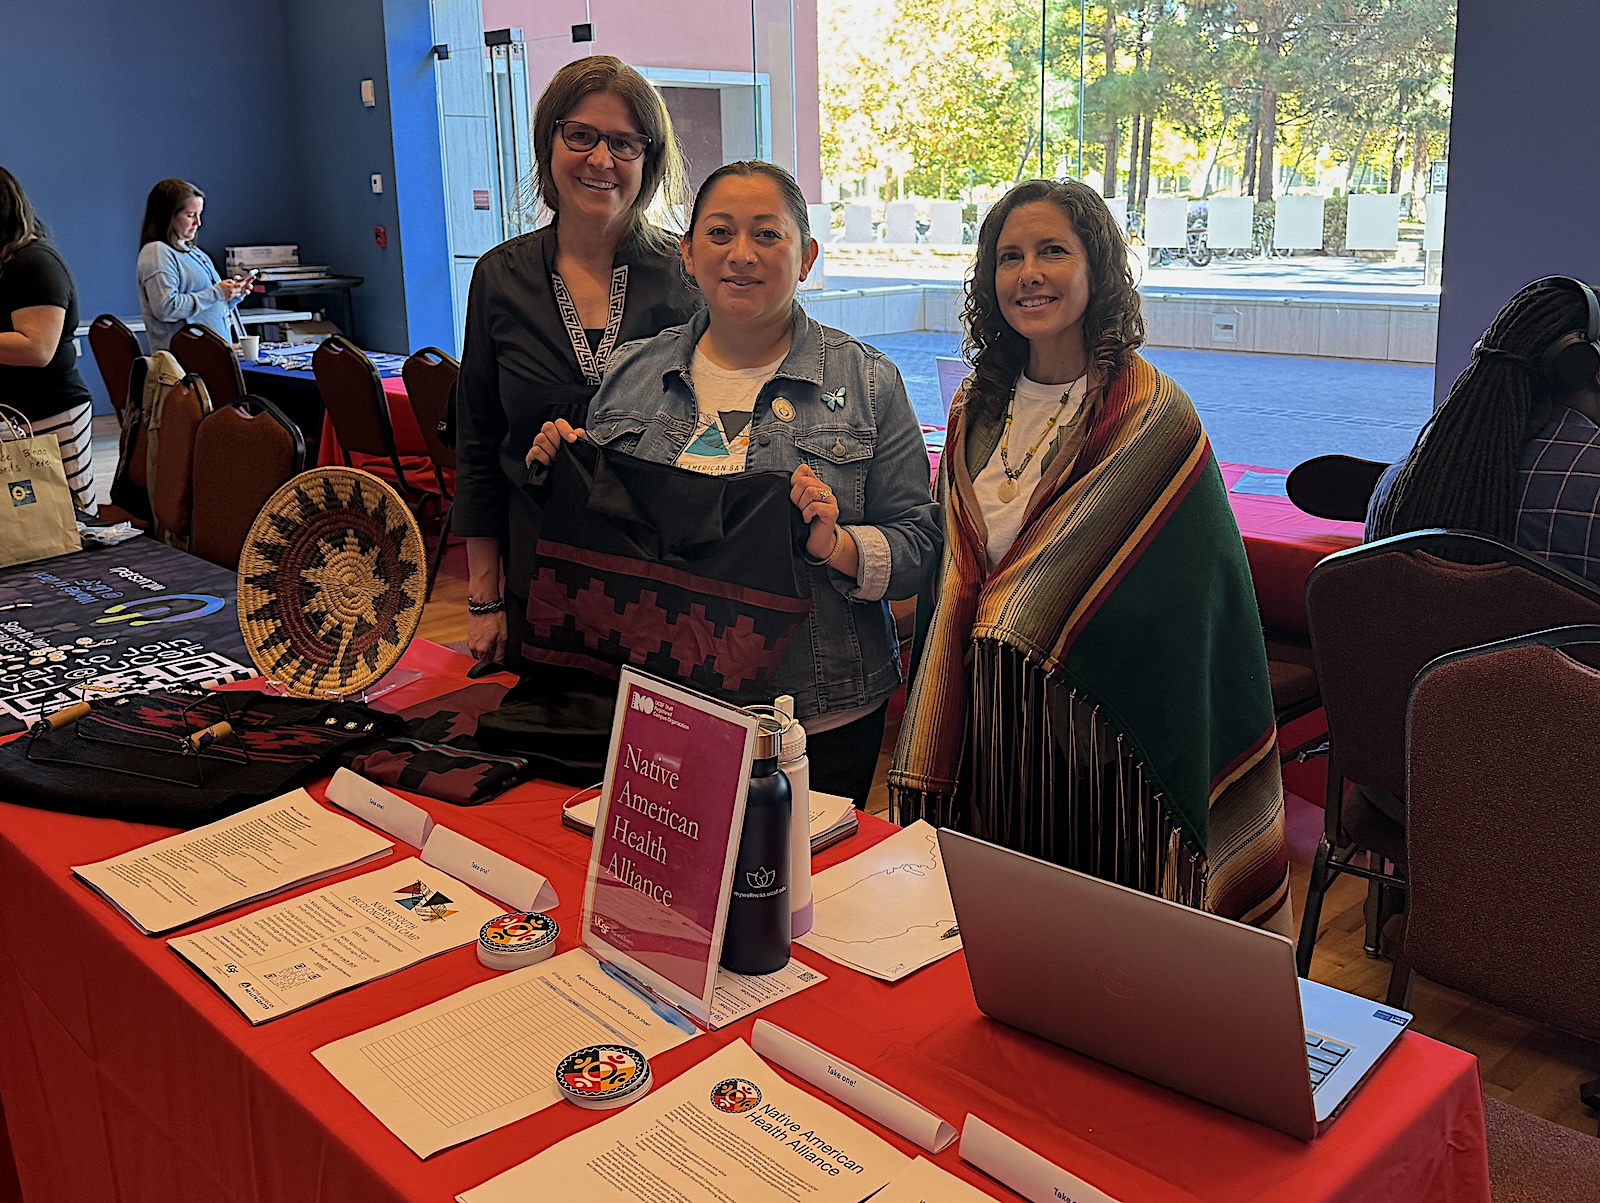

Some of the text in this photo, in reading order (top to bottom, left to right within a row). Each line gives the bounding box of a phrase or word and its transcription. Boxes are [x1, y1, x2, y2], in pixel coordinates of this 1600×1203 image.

[30, 460, 51, 469] here
[687, 464, 727, 472] AMERICAN
[74, 654, 111, 667] to
[123, 638, 192, 658] Join
[624, 743, 680, 790] Native
[617, 781, 700, 841] American
[612, 815, 668, 865] Health
[471, 861, 480, 871] Take
[605, 852, 674, 909] Alliance
[393, 913, 419, 930] YOUTH
[594, 915, 610, 936] UCSF
[398, 927, 420, 941] CAMP
[827, 1065, 857, 1088] Take one!
[744, 1111, 841, 1177] Health Alliance
[758, 1103, 865, 1174] Native American
[1053, 1187, 1071, 1203] Take
